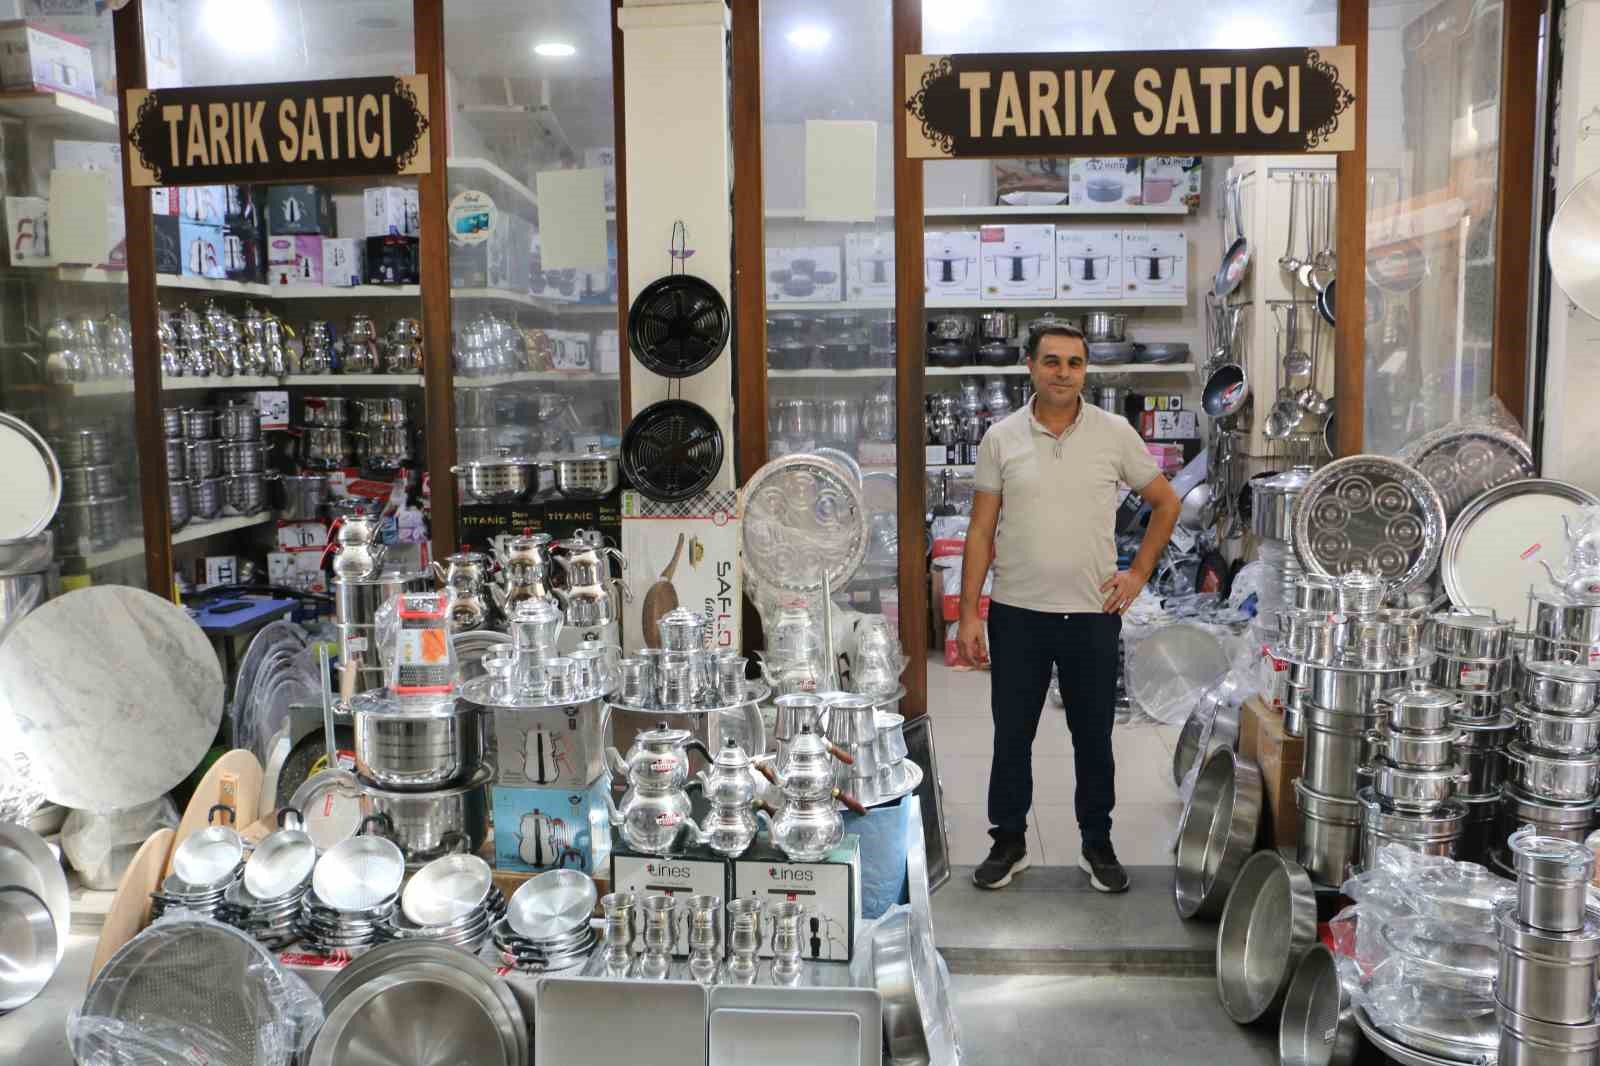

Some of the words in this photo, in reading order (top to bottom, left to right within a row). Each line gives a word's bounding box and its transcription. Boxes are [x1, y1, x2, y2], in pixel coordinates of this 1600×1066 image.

[162, 100, 269, 167] TARIK
[278, 93, 392, 163] SATICI
[959, 68, 1117, 138] TARIK
[1132, 65, 1301, 136] SATICI
